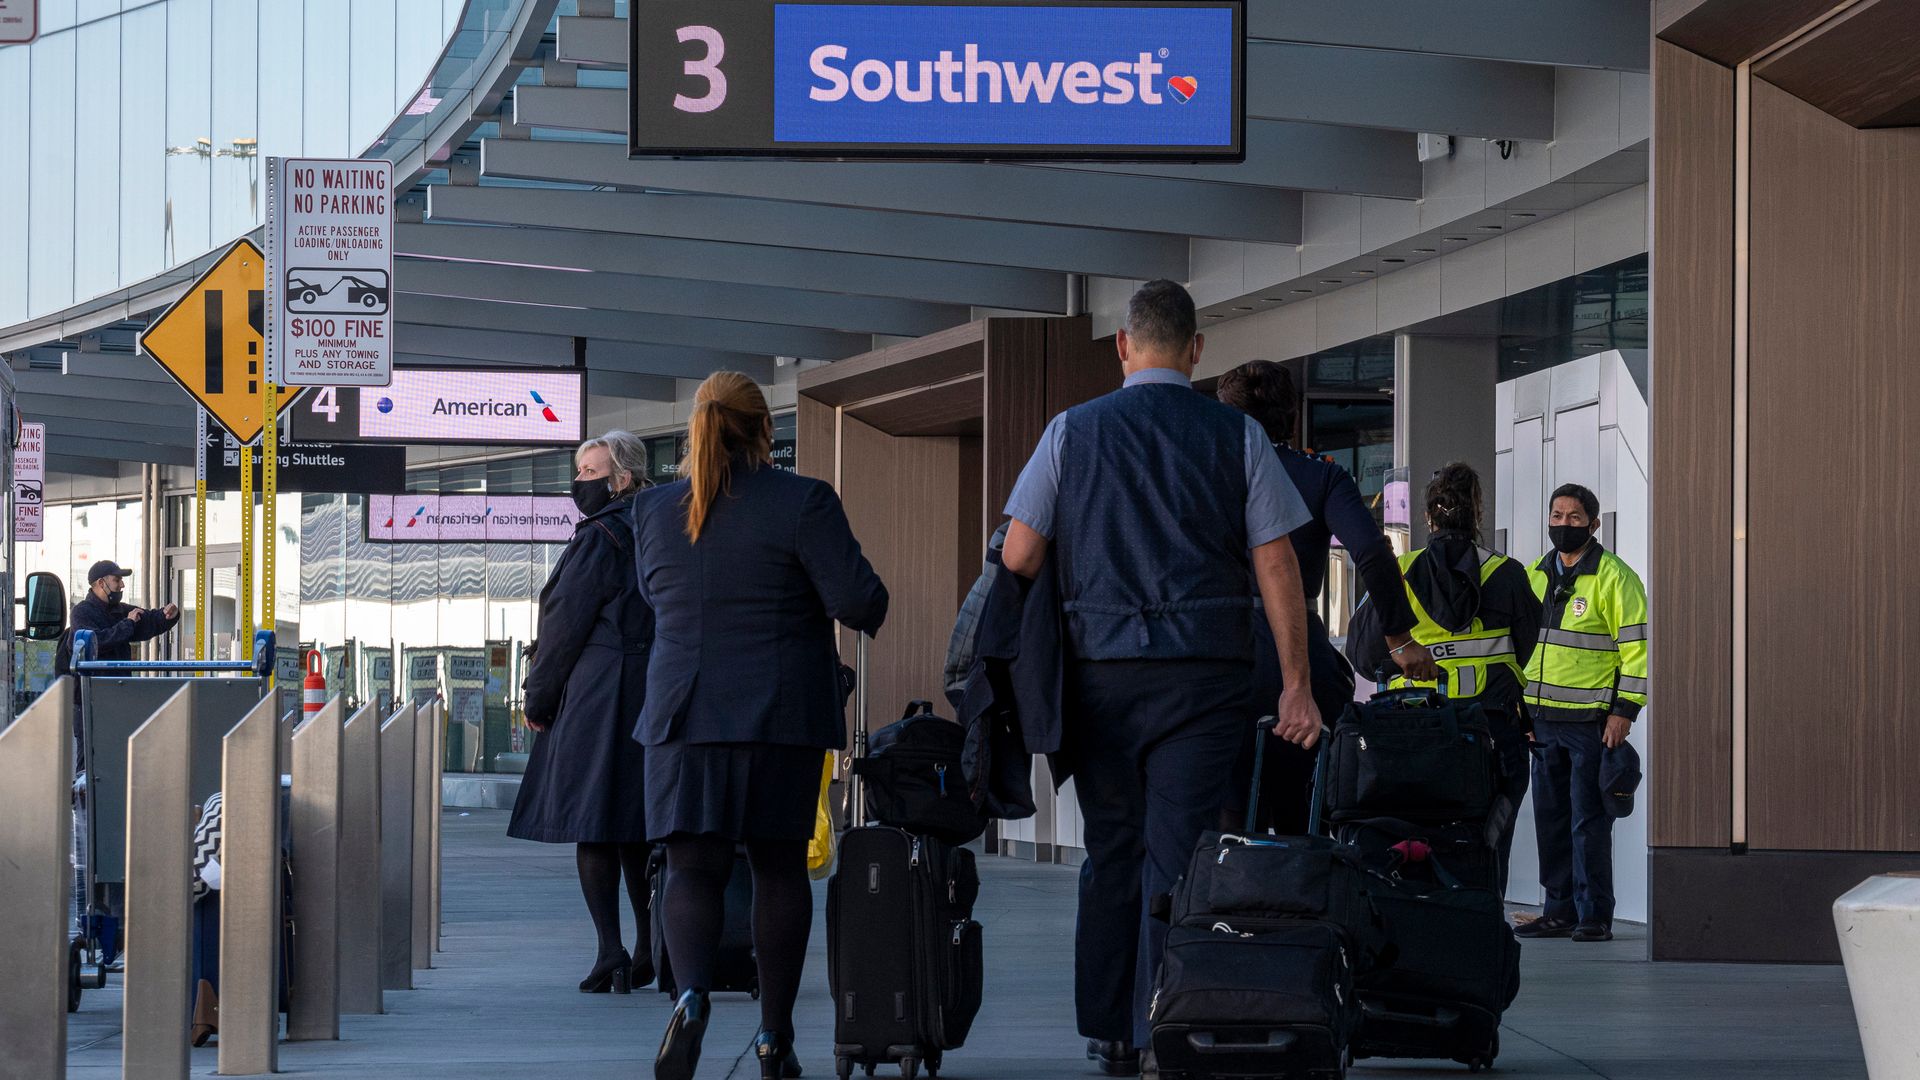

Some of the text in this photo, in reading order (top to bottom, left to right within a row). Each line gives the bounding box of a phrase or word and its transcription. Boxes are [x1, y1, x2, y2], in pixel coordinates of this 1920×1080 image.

[672, 25, 1163, 113] 3 Southwest
[294, 168, 385, 190] NO WAITING
[294, 194, 385, 215] NO PARKING
[298, 226, 380, 237] ACTIVE PASSENGER
[294, 238, 384, 250] LOADING/UNLOADING
[327, 250, 350, 261] ONLY
[290, 317, 384, 338] $100 FINE
[318, 339, 357, 348] MINIMUM
[295, 349, 379, 360] PLUS ANY TOWING
[298, 360, 376, 370] AND STORAGE
[312, 385, 528, 422] 4 American
[23, 428, 40, 439] TING
[292, 453, 345, 466] Shuttles
[19, 506, 39, 516] FINE
